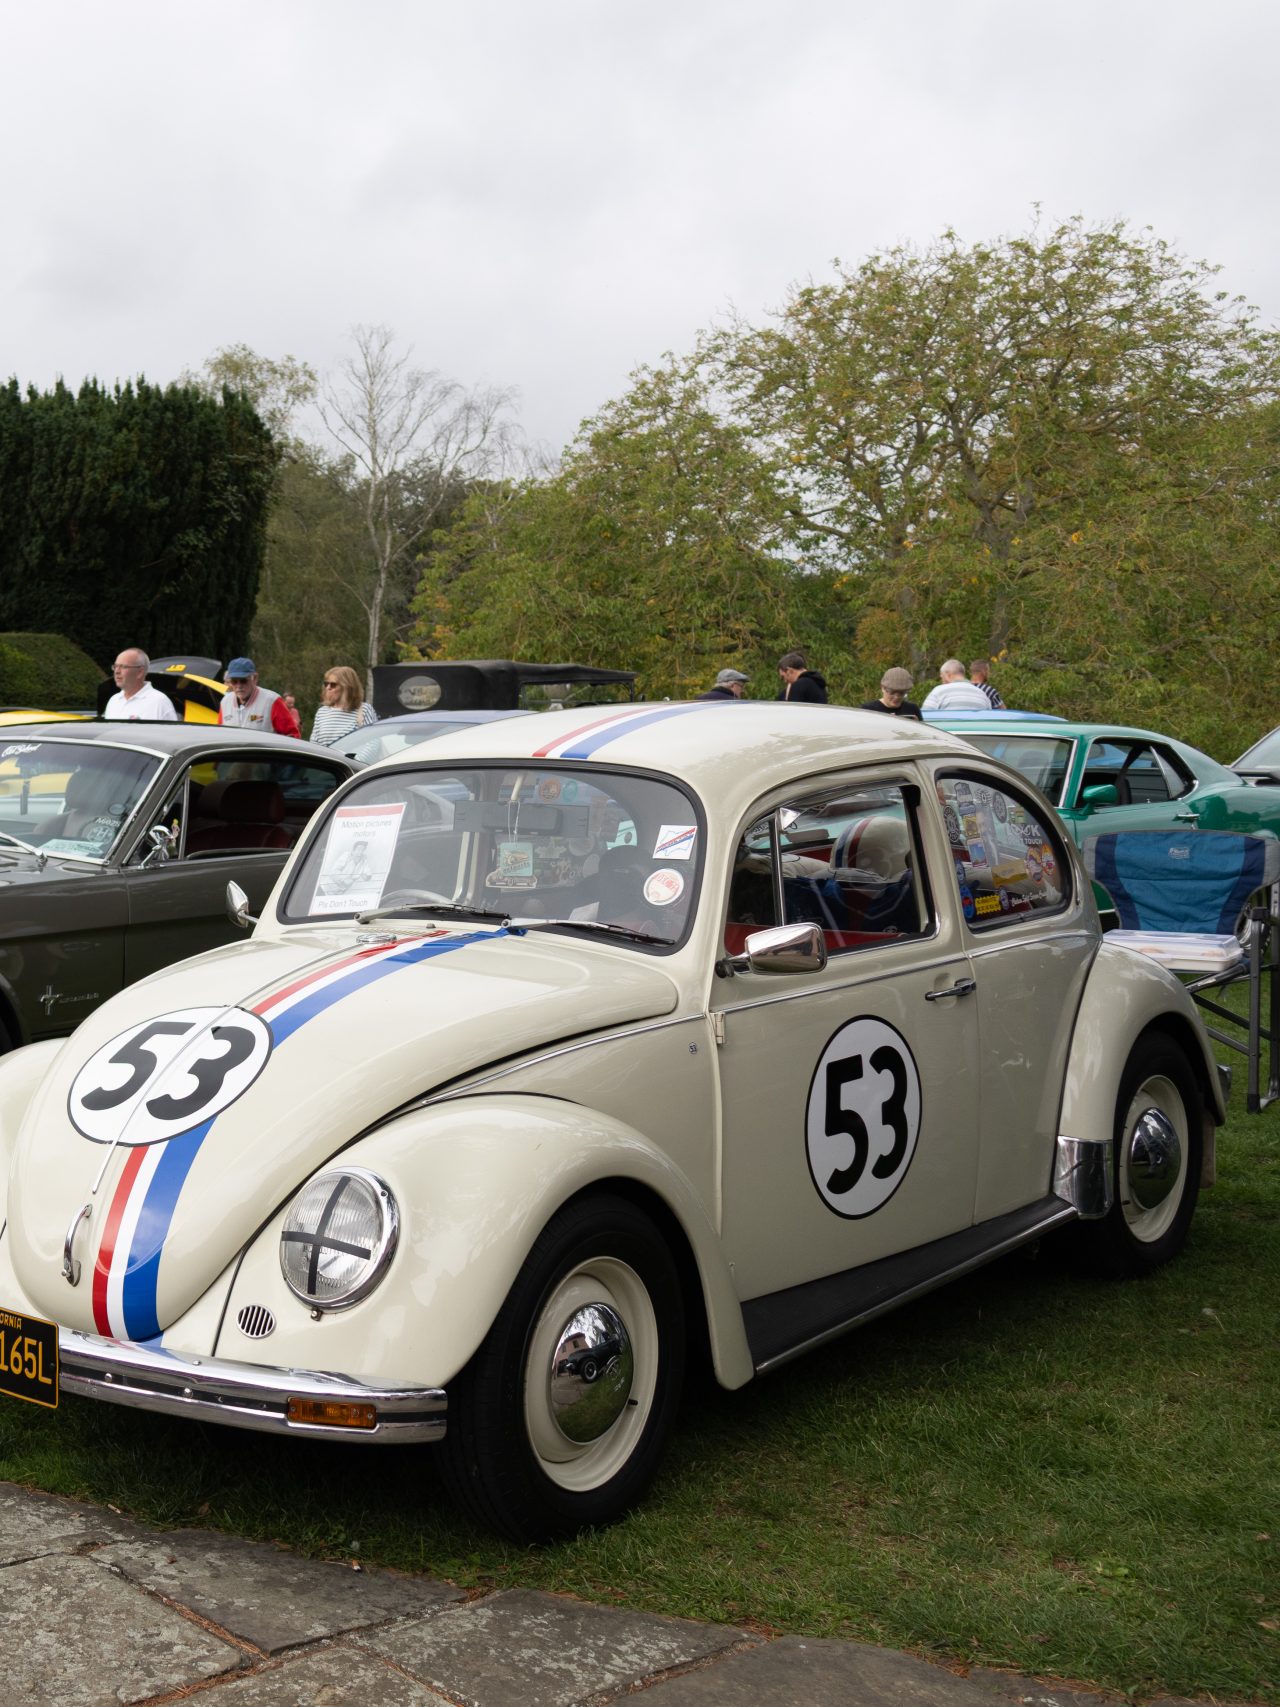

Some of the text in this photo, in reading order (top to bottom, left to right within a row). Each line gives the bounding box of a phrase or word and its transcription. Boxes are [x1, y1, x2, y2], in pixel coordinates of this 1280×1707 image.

[349, 899, 368, 907] Touch
[81, 1021, 256, 1121] 53
[825, 1045, 909, 1195] 53
